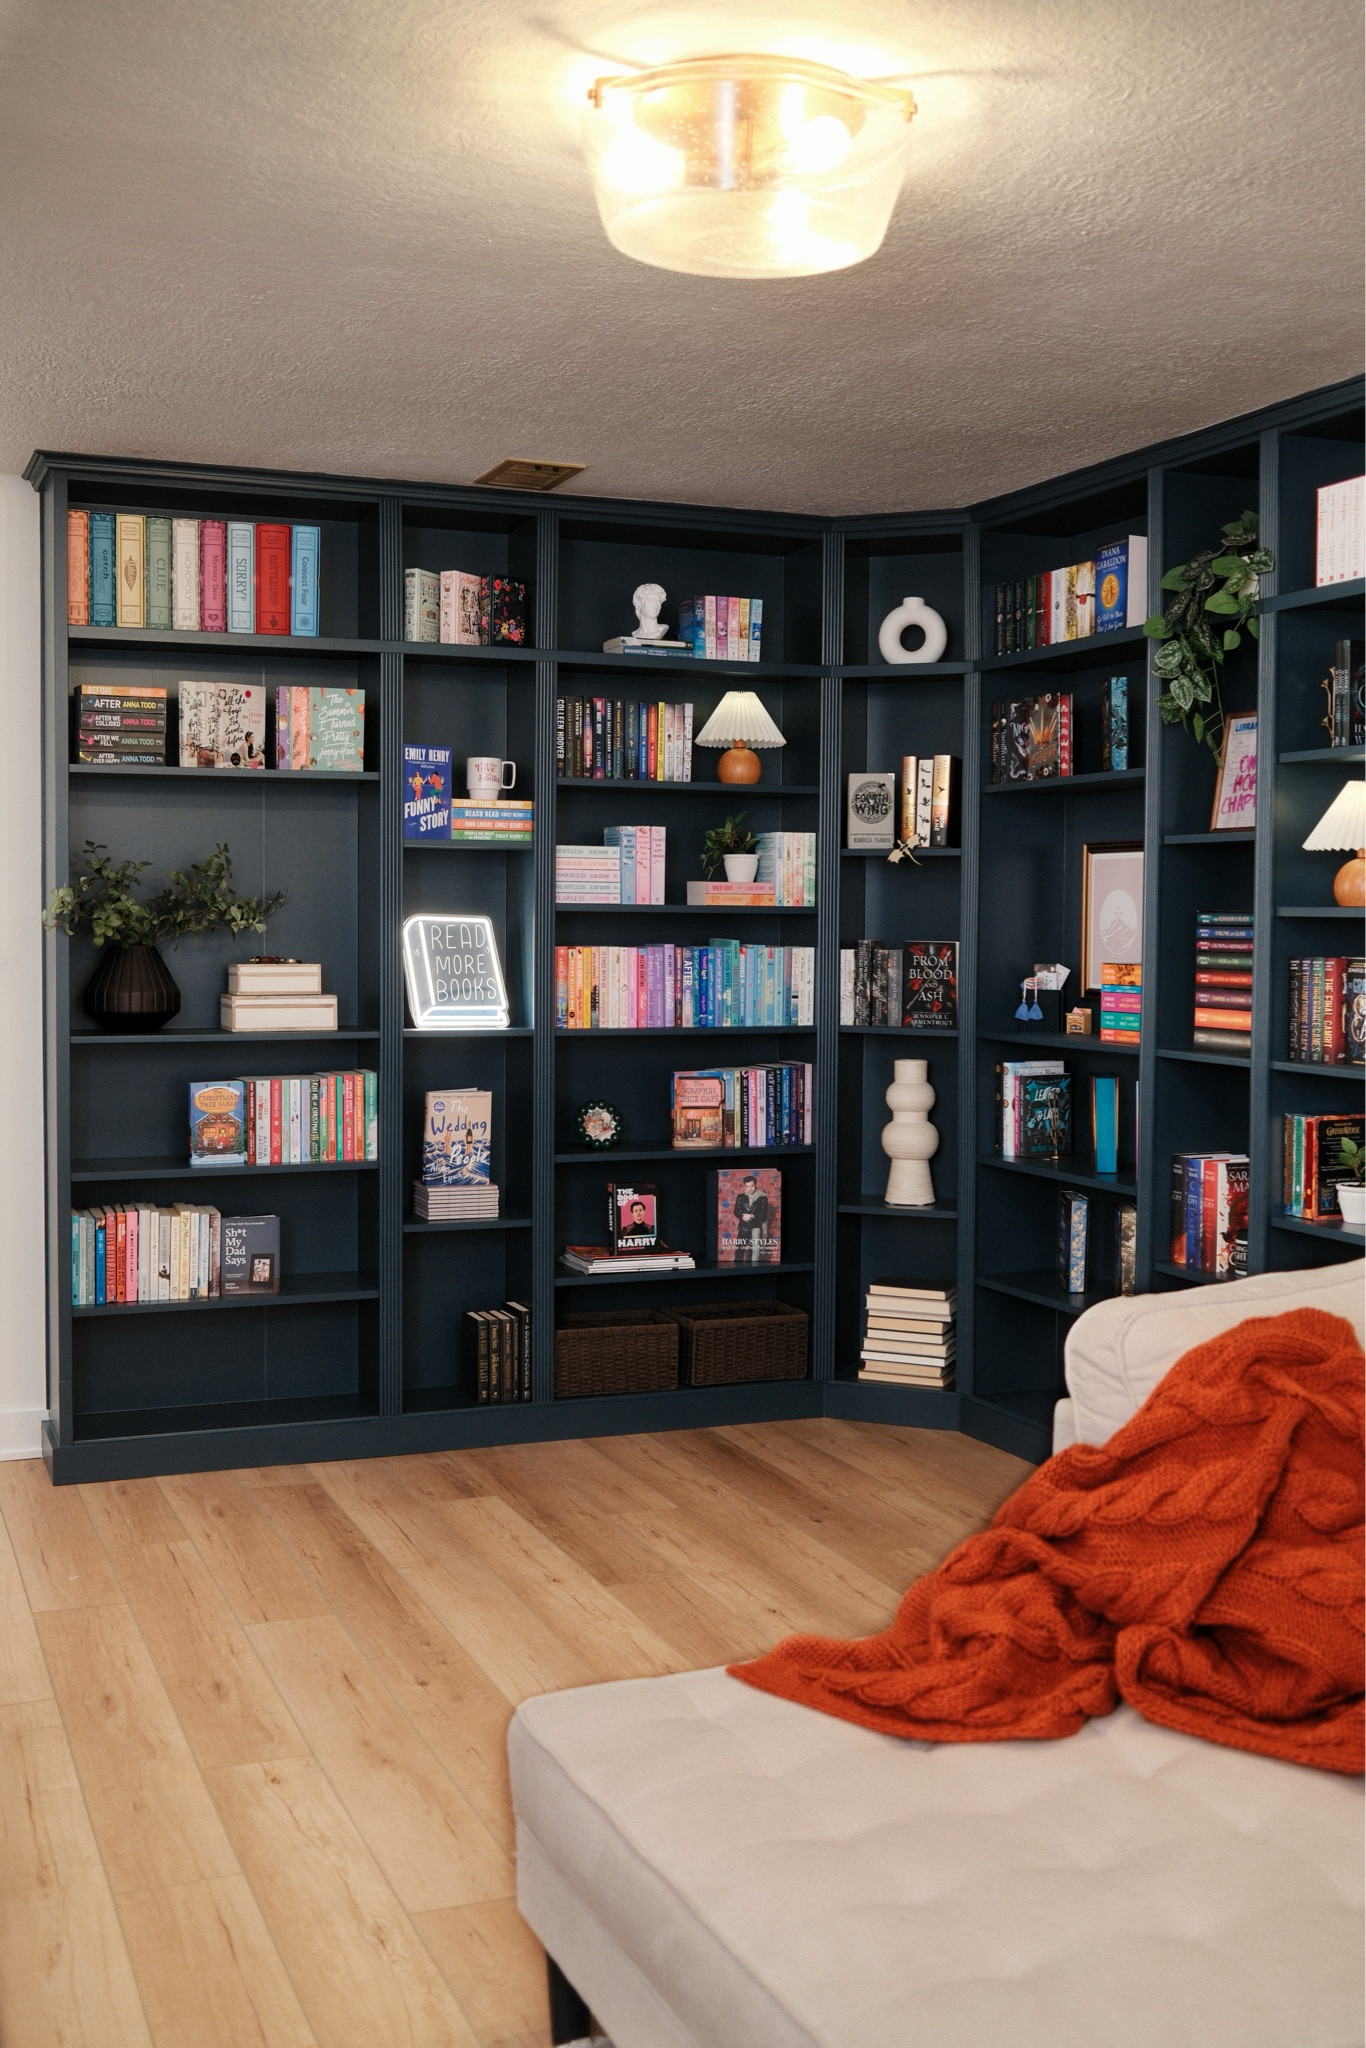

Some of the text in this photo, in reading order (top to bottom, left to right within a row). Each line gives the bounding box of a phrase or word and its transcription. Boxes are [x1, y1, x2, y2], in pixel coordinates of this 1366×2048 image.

[1102, 546, 1120, 558] DIANA
[1096, 555, 1126, 570] GABALDON
[156, 558, 166, 591] CLUE
[301, 556, 310, 586] Connect
[94, 699, 120, 708] AFTER
[326, 694, 343, 706] The
[318, 706, 355, 720] Summer
[327, 718, 356, 729] Turned
[1235, 722, 1257, 732] LIBRA
[322, 731, 350, 744] Pretty
[317, 748, 338, 761] Jenny
[405, 748, 450, 763] EMILY HENRY
[1240, 755, 1256, 774] ON
[1233, 774, 1256, 793] MOR
[855, 793, 888, 802] FOURTH
[404, 796, 437, 818] FUNNY
[854, 804, 888, 815] WING
[420, 810, 448, 832] STORY
[431, 924, 486, 950] READ
[436, 954, 486, 975] MORE
[913, 956, 948, 967] FROM
[684, 960, 692, 985] AFTER
[909, 968, 952, 979] BLOOD
[436, 978, 496, 1001] BOOKS
[918, 992, 943, 1002] ASH
[1323, 978, 1333, 1048] THE FINAL GAMBIT
[450, 1100, 469, 1113] The
[450, 1145, 488, 1170] People
[1228, 1172, 1249, 1181] SAR
[1233, 1182, 1249, 1192] MA
[1188, 1197, 1198, 1205] CITY
[225, 1238, 241, 1247] My
[618, 1237, 656, 1247] HARRY
[225, 1246, 245, 1255] Dad
[225, 1256, 246, 1266] Says
